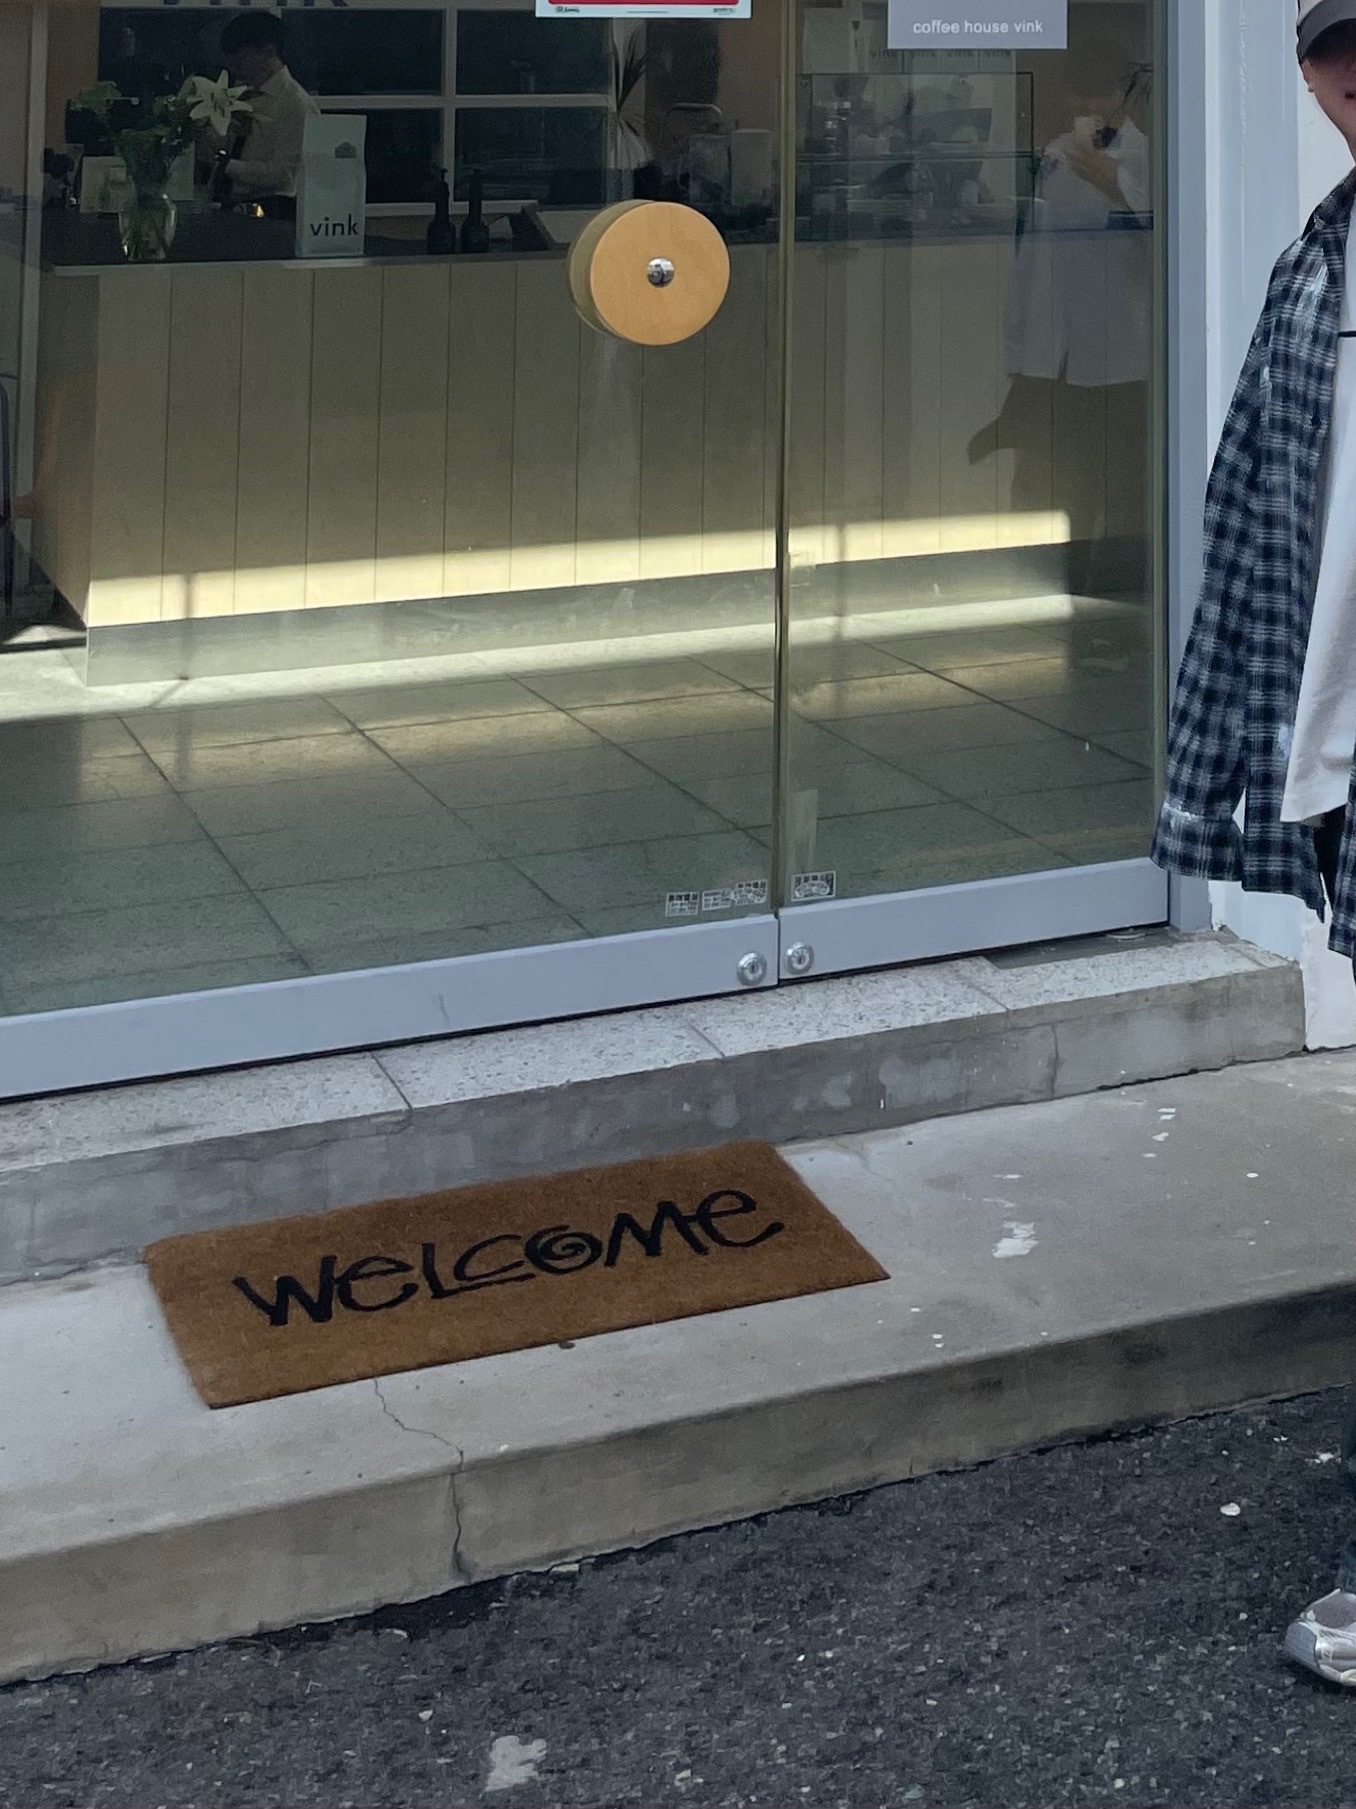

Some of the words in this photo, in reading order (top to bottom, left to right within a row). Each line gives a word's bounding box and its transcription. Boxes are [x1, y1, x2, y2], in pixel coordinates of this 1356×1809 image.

[913, 19, 960, 34] coffee
[964, 19, 1009, 34] house
[1014, 19, 1044, 34] vink
[310, 214, 359, 237] vink
